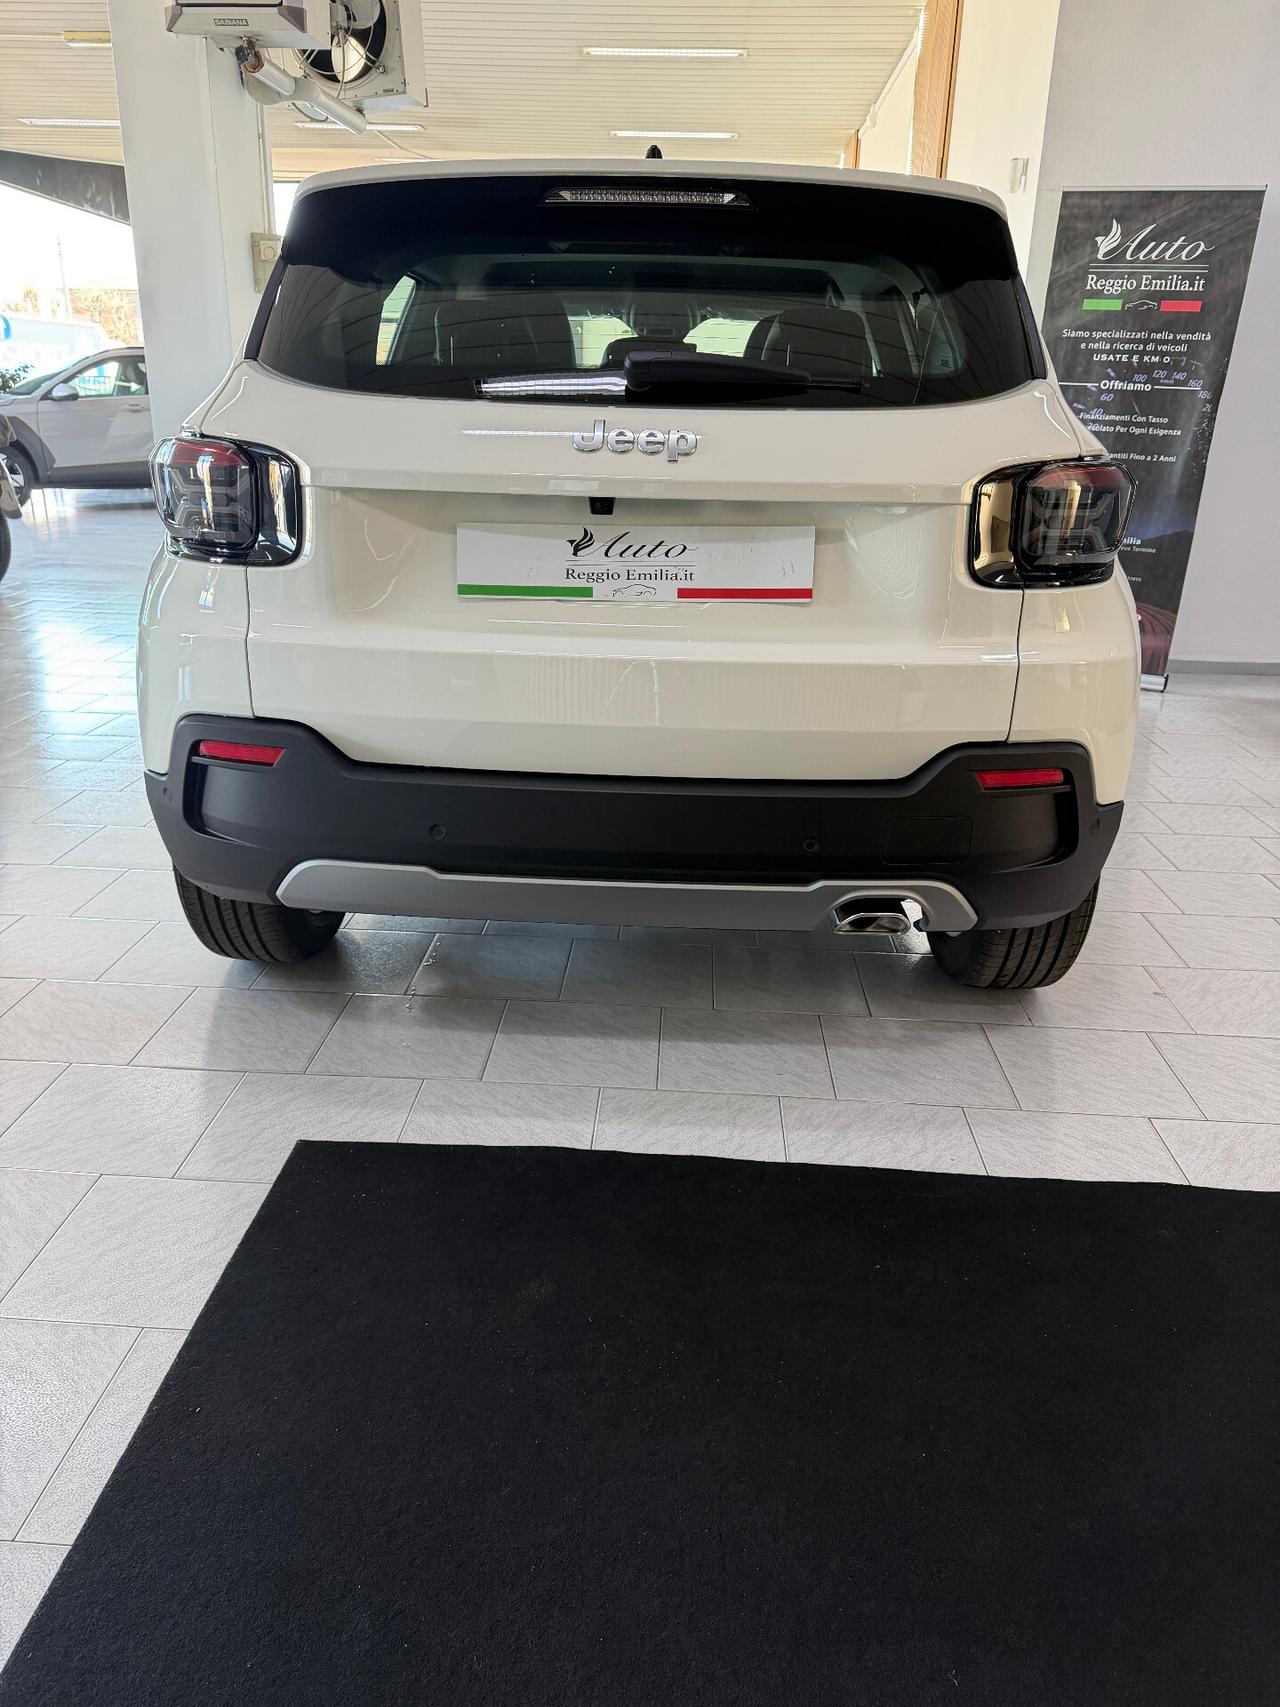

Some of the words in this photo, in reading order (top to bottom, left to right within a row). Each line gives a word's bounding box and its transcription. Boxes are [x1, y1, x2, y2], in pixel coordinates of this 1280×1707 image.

[1100, 223, 1216, 261] Auto
[1086, 274, 1137, 295] Reggio
[1140, 274, 1206, 292] Emilia.it
[1062, 328, 1090, 338] Siamo
[1091, 329, 1149, 340] specializzati
[1150, 331, 1174, 340] nella
[1176, 331, 1212, 341] vendità
[1080, 342, 1086, 350] e
[1088, 341, 1111, 350] nella
[1112, 341, 1144, 351] ricerca
[1145, 342, 1156, 351] di
[1157, 343, 1188, 352] veicoli
[1093, 353, 1129, 362] USATE
[1132, 354, 1140, 362] E
[1143, 355, 1160, 363] KM
[1132, 373, 1148, 382] 100
[1152, 369, 1168, 379] 120
[1171, 371, 1188, 380] 140
[1100, 379, 1152, 392] Offriamo
[1187, 379, 1204, 388] 160
[1100, 393, 1114, 402] 60
[1131, 414, 1147, 423] Con
[1147, 415, 1169, 424] Tasso
[1115, 425, 1128, 433] Per
[1128, 426, 1148, 436] Ogni
[1148, 427, 1182, 437] Esigenza
[572, 419, 698, 464] Jeep
[1107, 452, 1129, 460] antiti
[1129, 453, 1146, 461] Fino
[1159, 454, 1177, 462] Anni
[578, 530, 699, 559] Auto
[564, 567, 621, 584] Reggio
[626, 568, 695, 581] Emilia.it
